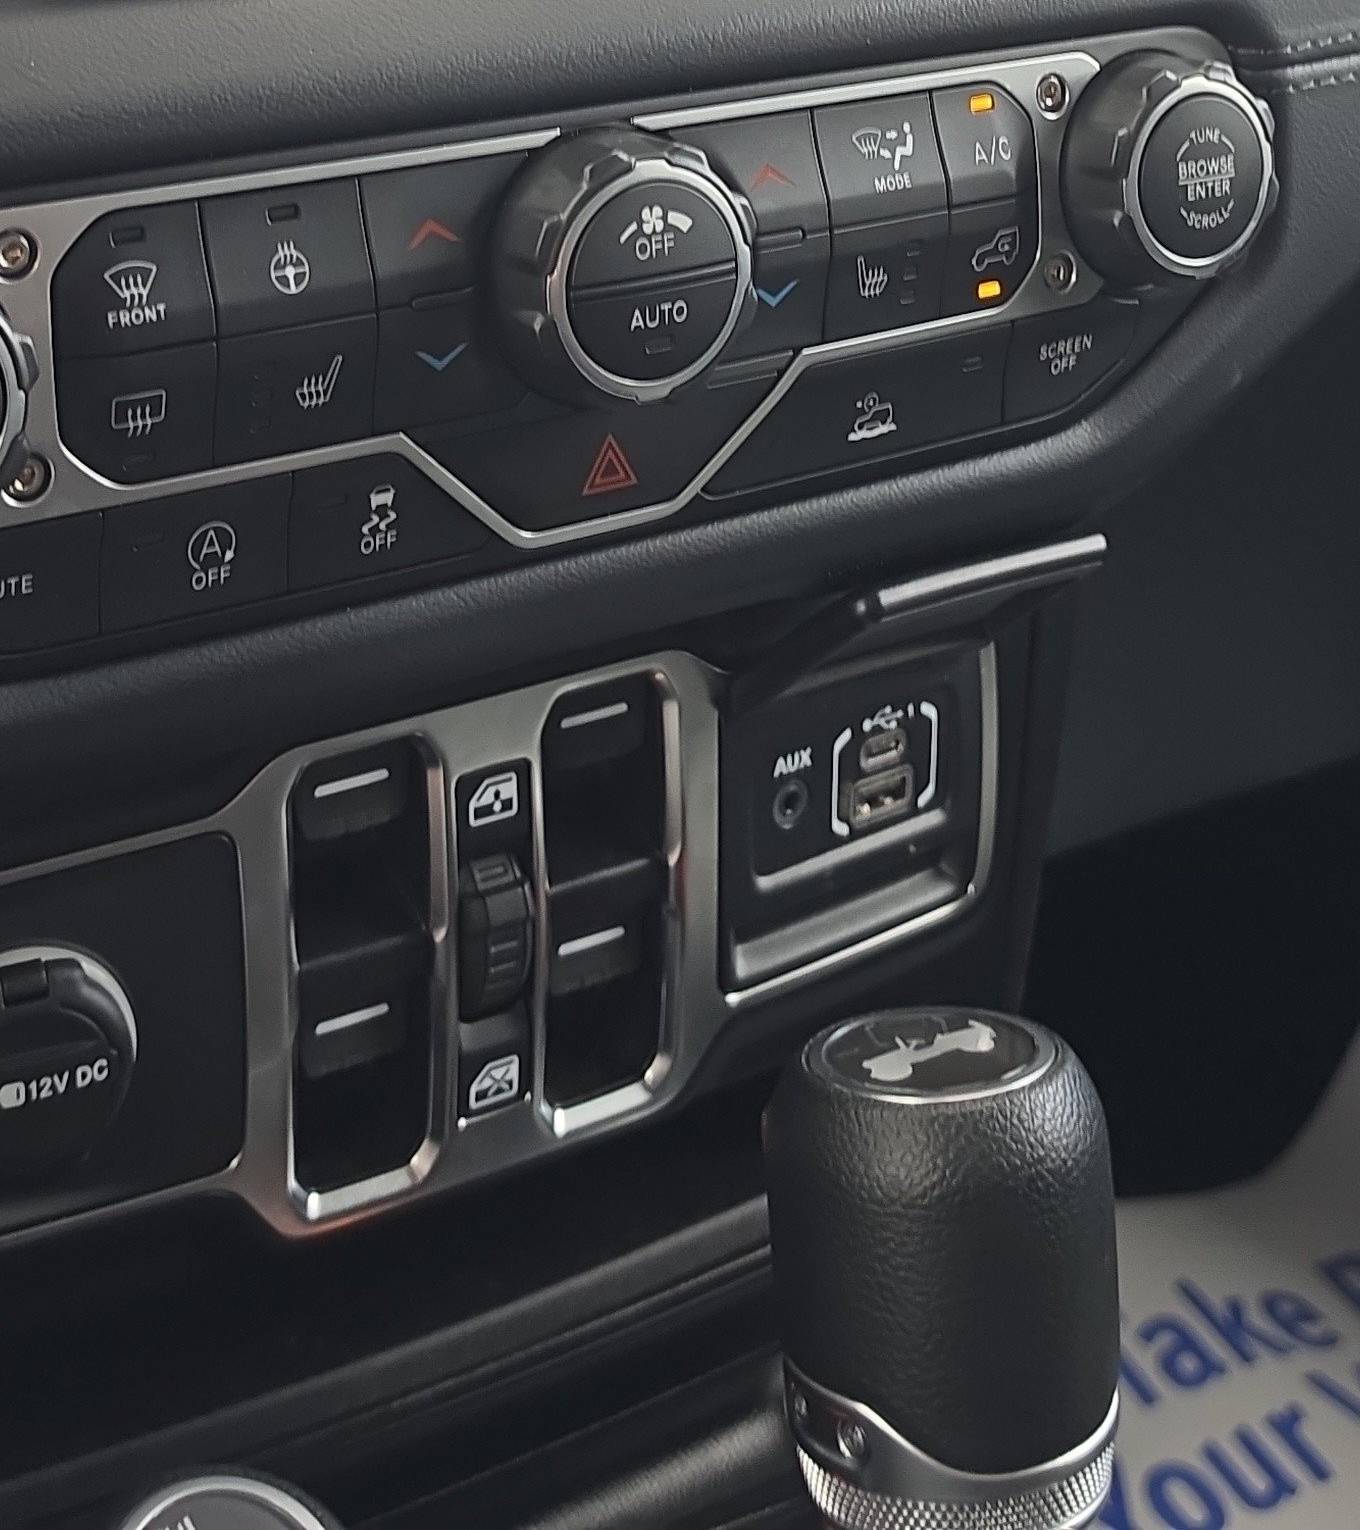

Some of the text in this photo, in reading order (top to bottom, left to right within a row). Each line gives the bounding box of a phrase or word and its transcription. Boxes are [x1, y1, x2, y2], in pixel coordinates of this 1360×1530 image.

[1189, 126, 1221, 147] TUNE
[973, 137, 1013, 166] A/C
[1178, 154, 1235, 181] BROWSE
[874, 172, 913, 194] MODE
[1187, 178, 1231, 202] ENTER
[1185, 206, 1230, 230] SCROLL
[635, 232, 676, 261] OFF
[107, 303, 167, 329] FRONT
[630, 299, 689, 332] AUTO
[1039, 333, 1092, 361] SCREEN
[1050, 356, 1077, 375] OFF
[359, 529, 397, 554] OFF
[191, 564, 231, 591] OFF
[773, 746, 812, 778] AUX
[28, 1057, 110, 1102] 12V DC
